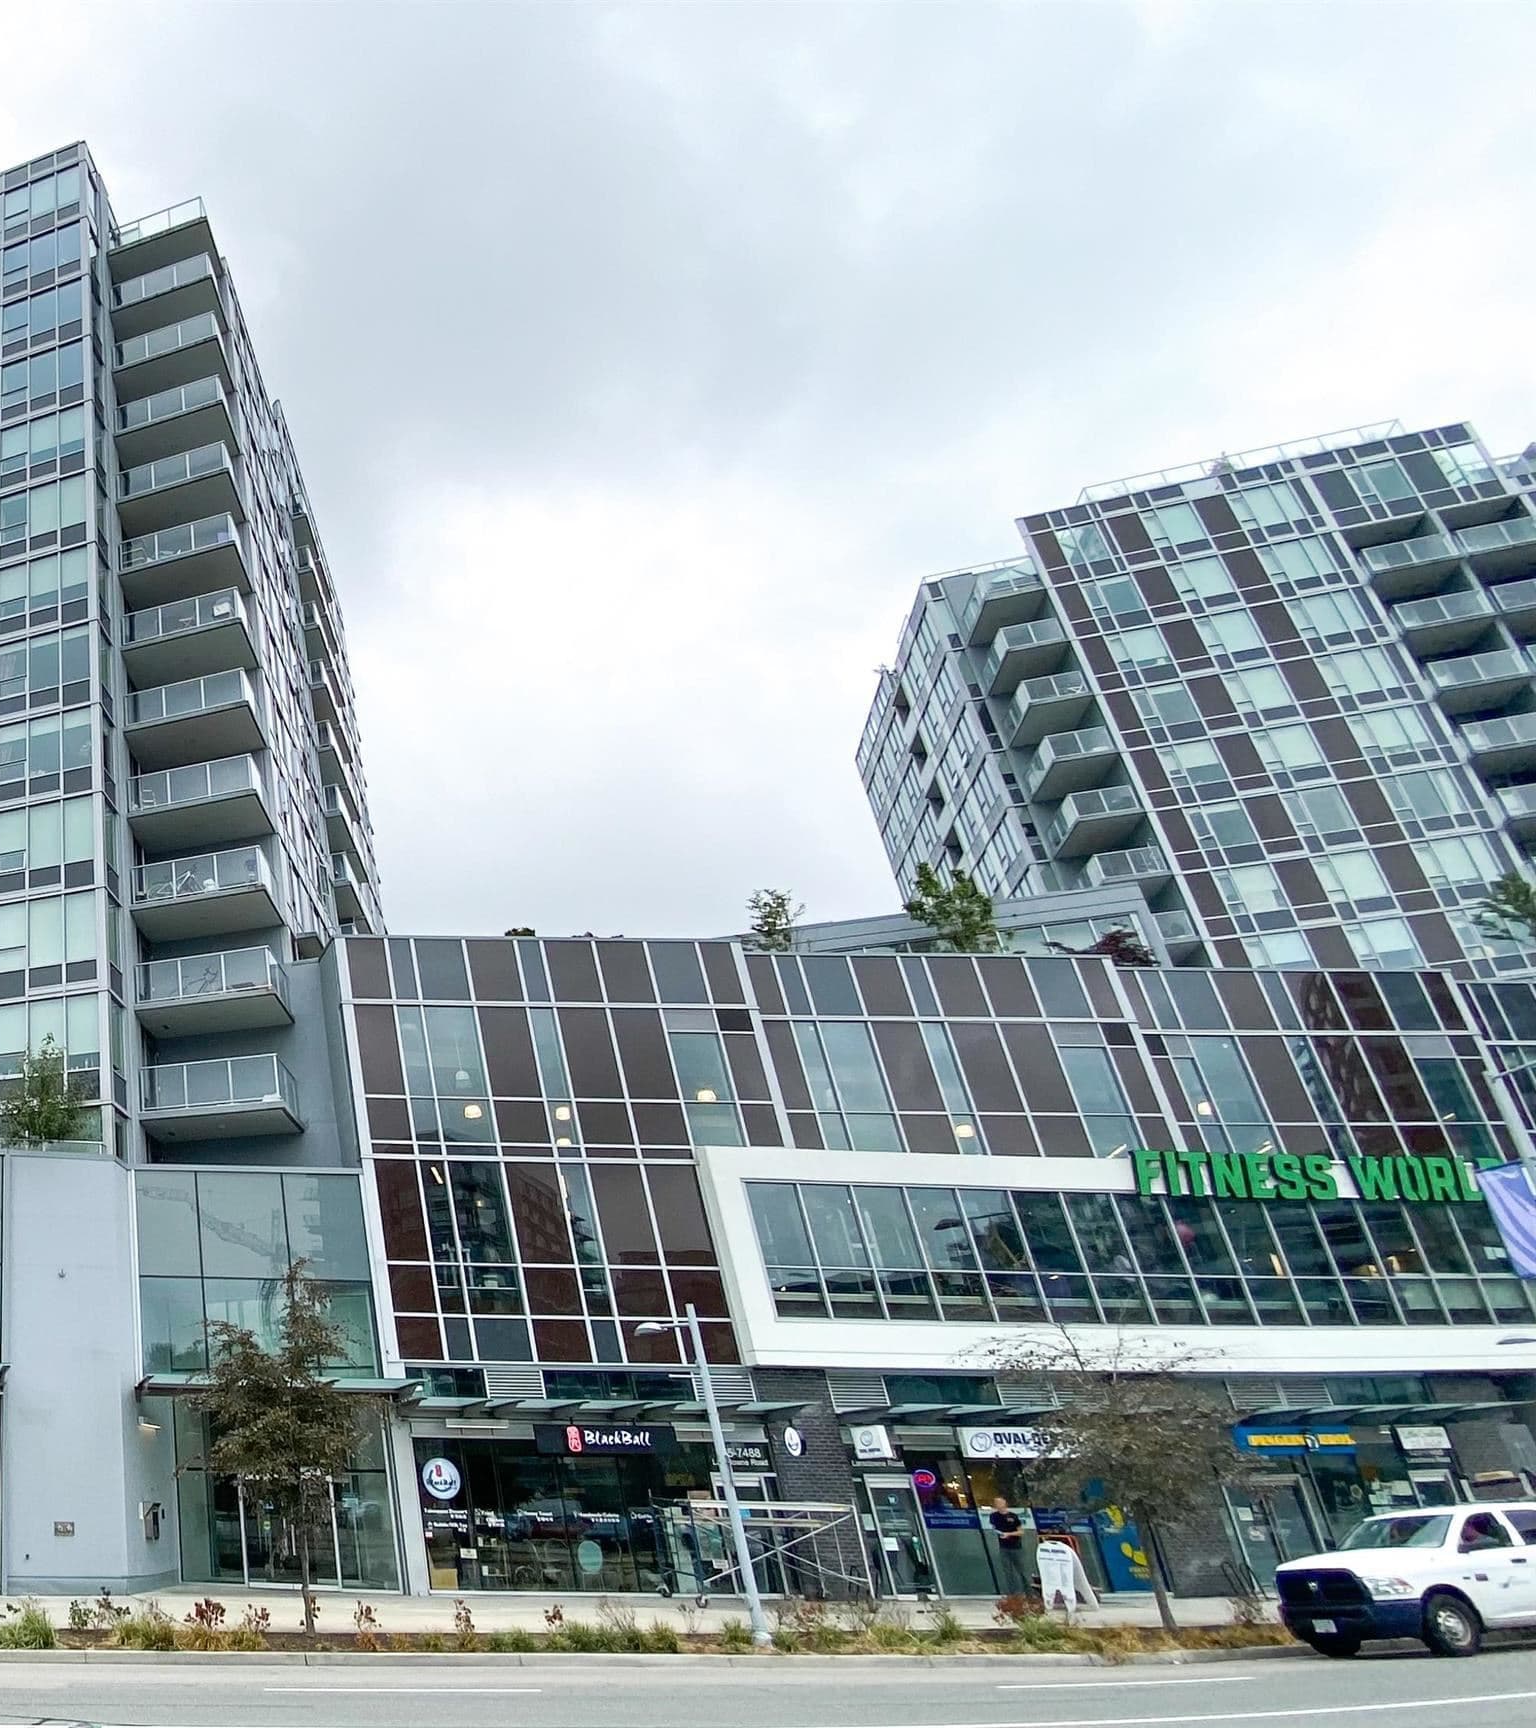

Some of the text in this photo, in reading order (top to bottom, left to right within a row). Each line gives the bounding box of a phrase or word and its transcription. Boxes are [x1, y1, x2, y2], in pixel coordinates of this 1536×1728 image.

[1133, 1150, 1339, 1200] FITNESS
[583, 1429, 652, 1447] BlackBall
[992, 1432, 1031, 1446] OVAL
[726, 1446, 762, 1459] 5-7488
